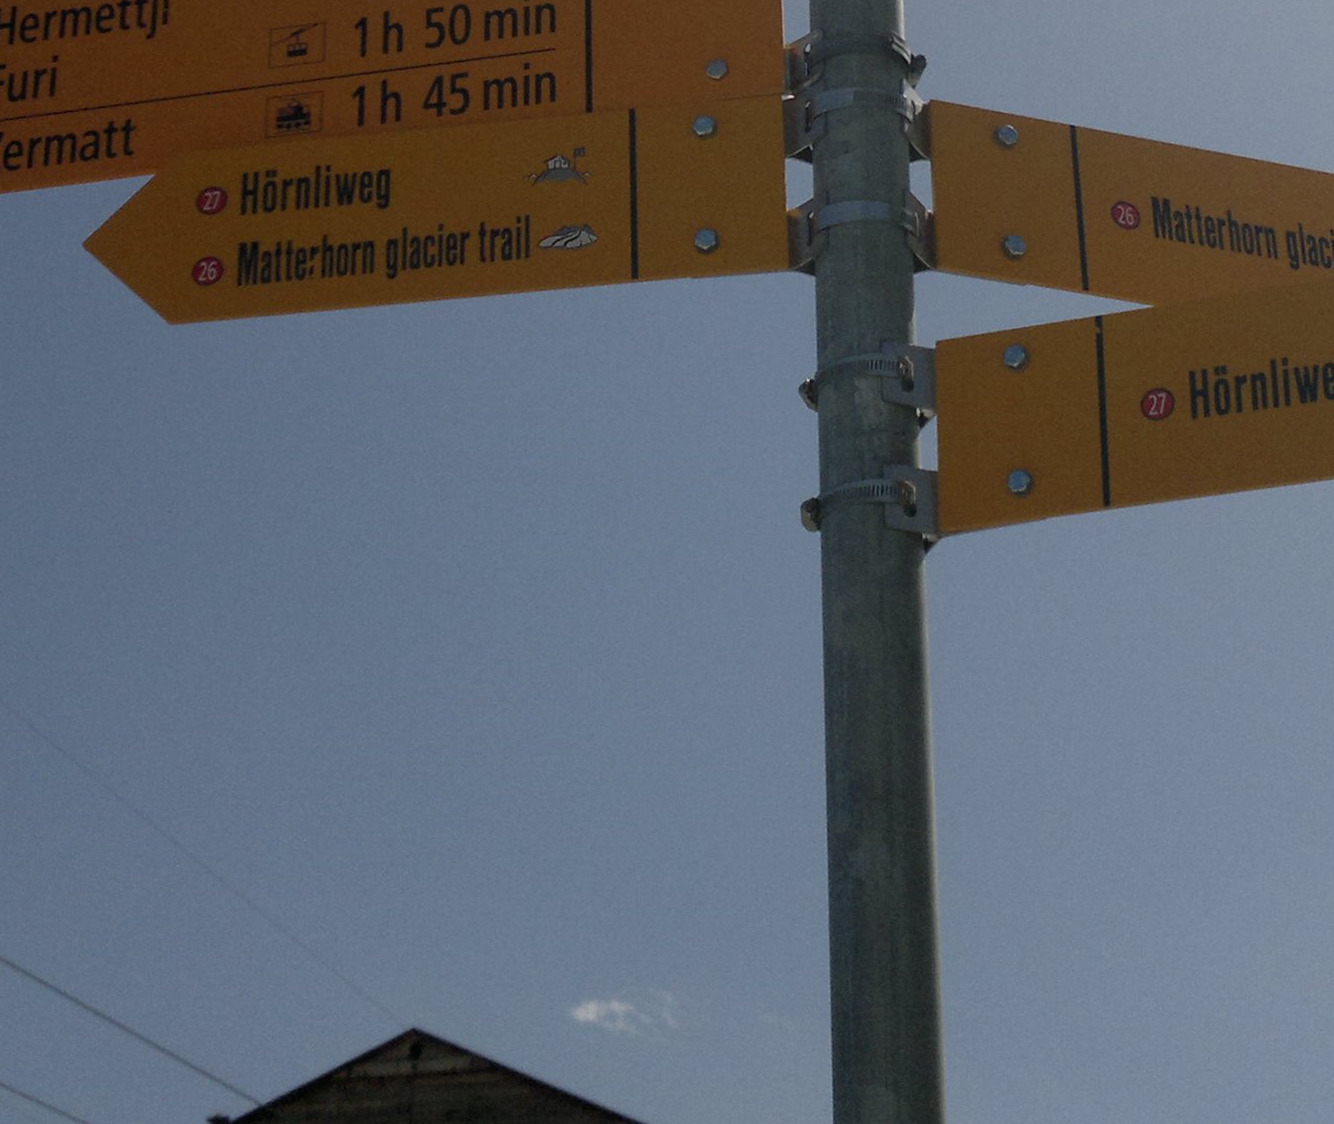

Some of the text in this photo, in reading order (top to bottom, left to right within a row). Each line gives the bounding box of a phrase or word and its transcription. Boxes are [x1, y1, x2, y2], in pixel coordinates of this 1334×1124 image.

[424, 3, 473, 49] 50
[424, 71, 471, 117] 45
[483, 62, 556, 111] min
[202, 165, 391, 216] 27 Hörnliweg
[199, 214, 532, 287] 26 Matterhorn glacier trail
[1118, 205, 1135, 226] 26
[1152, 197, 1279, 260] Matterhorn
[1149, 393, 1168, 415] 27
